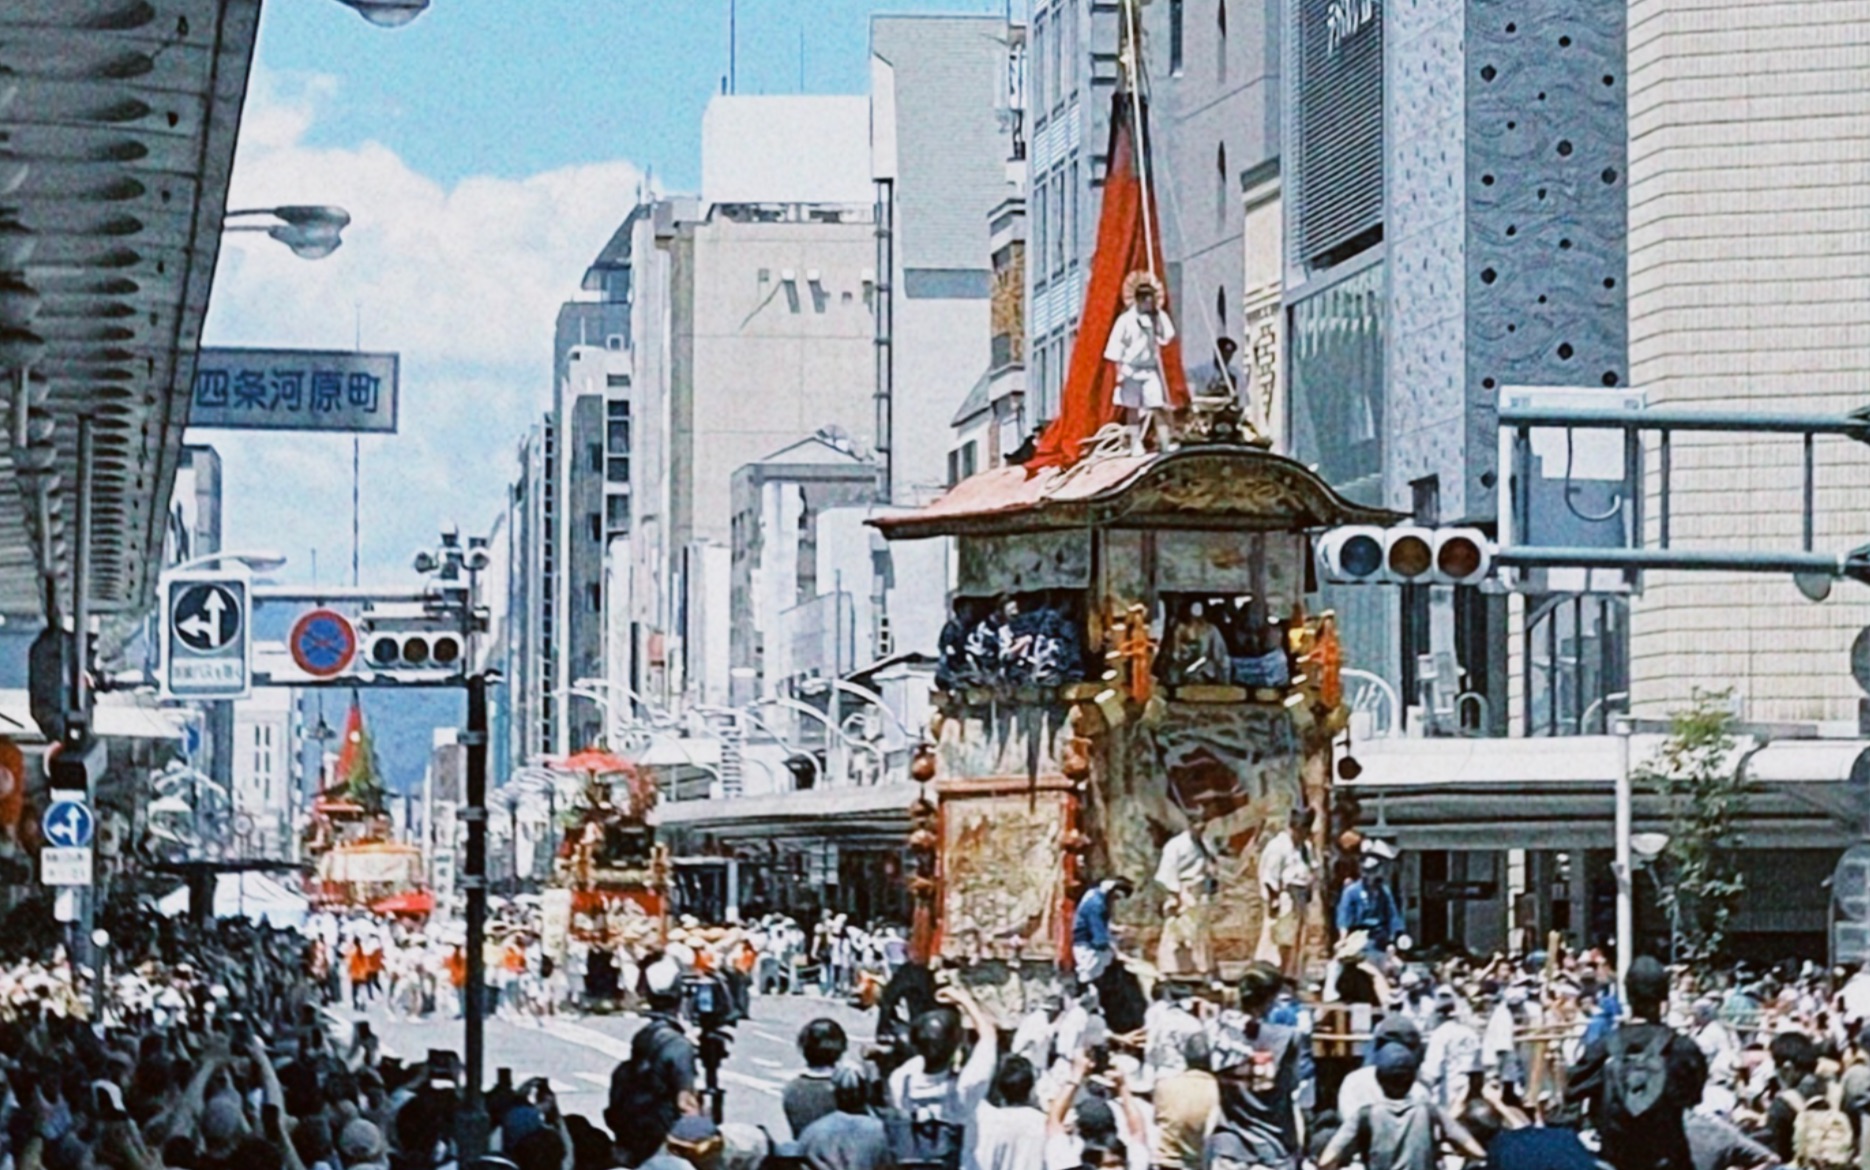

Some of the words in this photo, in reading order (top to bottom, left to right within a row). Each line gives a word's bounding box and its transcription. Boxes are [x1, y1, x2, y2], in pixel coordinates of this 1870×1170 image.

[196, 369, 380, 412] 四条河原町
